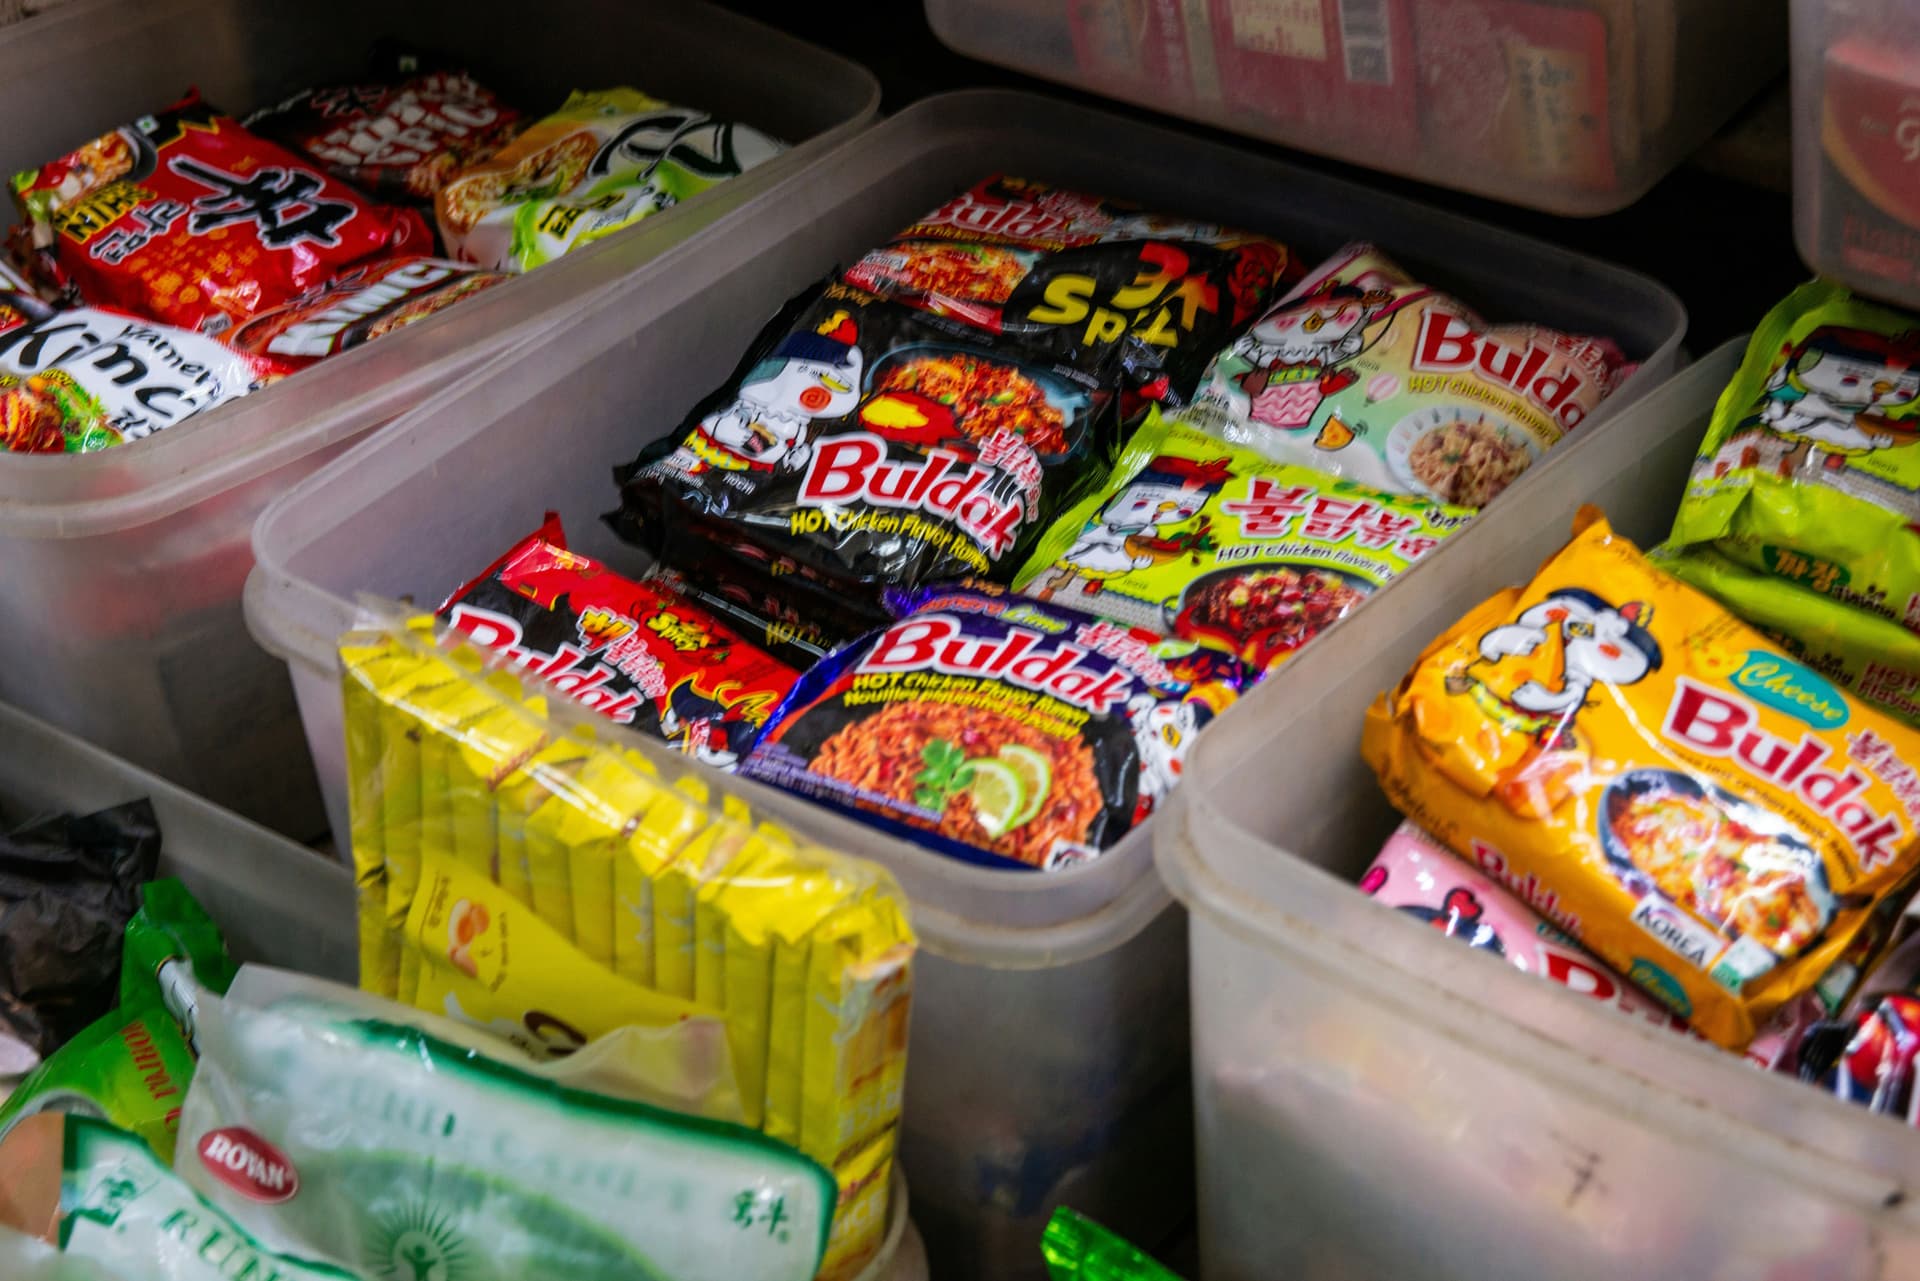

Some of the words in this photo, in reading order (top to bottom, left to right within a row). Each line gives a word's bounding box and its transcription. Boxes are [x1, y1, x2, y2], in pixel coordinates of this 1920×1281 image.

[1413, 308, 1587, 432] Bulda
[790, 509, 832, 537] HOT
[798, 434, 1024, 560] Buldak
[1215, 544, 1260, 564] HOT
[853, 673, 902, 691] HOT
[855, 614, 1132, 714] Buldak
[1737, 661, 1844, 720] Cheese
[1662, 674, 1903, 873] Buldak
[1635, 905, 1708, 966] KOREA
